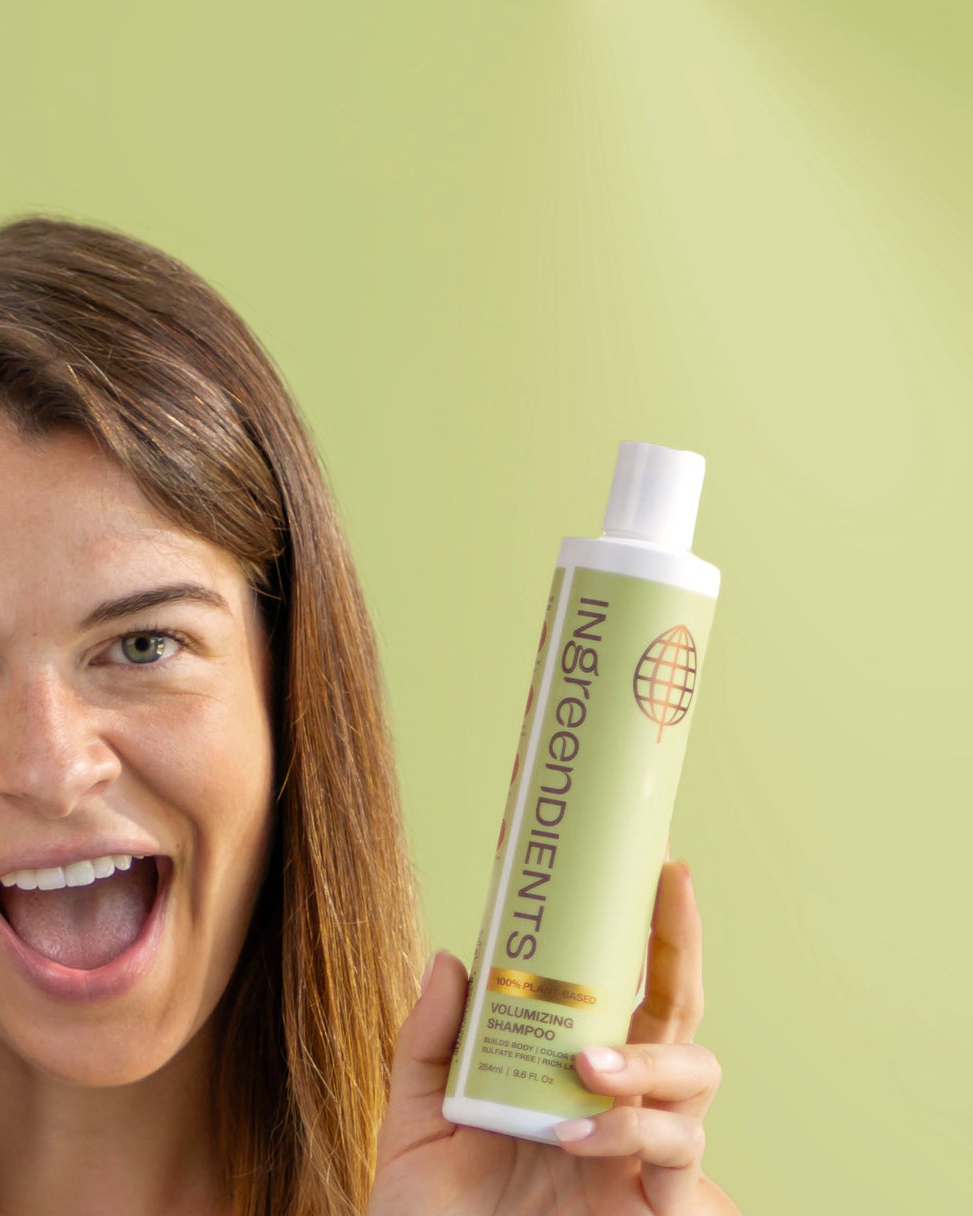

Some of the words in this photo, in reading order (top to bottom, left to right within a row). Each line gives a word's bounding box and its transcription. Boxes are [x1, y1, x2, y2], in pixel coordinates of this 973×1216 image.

[505, 597, 610, 962] INgreenDIENTS
[496, 976, 521, 989] 100%
[491, 1001, 574, 1029] VOLUMIZING
[487, 1017, 556, 1041] SHAMPOO
[481, 1045, 513, 1058] SULFATE
[514, 1052, 536, 1063] FREE
[542, 1058, 563, 1069] RICH
[483, 1036, 510, 1048] BUILDS
[511, 1041, 534, 1052] BODY
[540, 1047, 569, 1060] COLOR
[478, 1061, 504, 1073] 284ml
